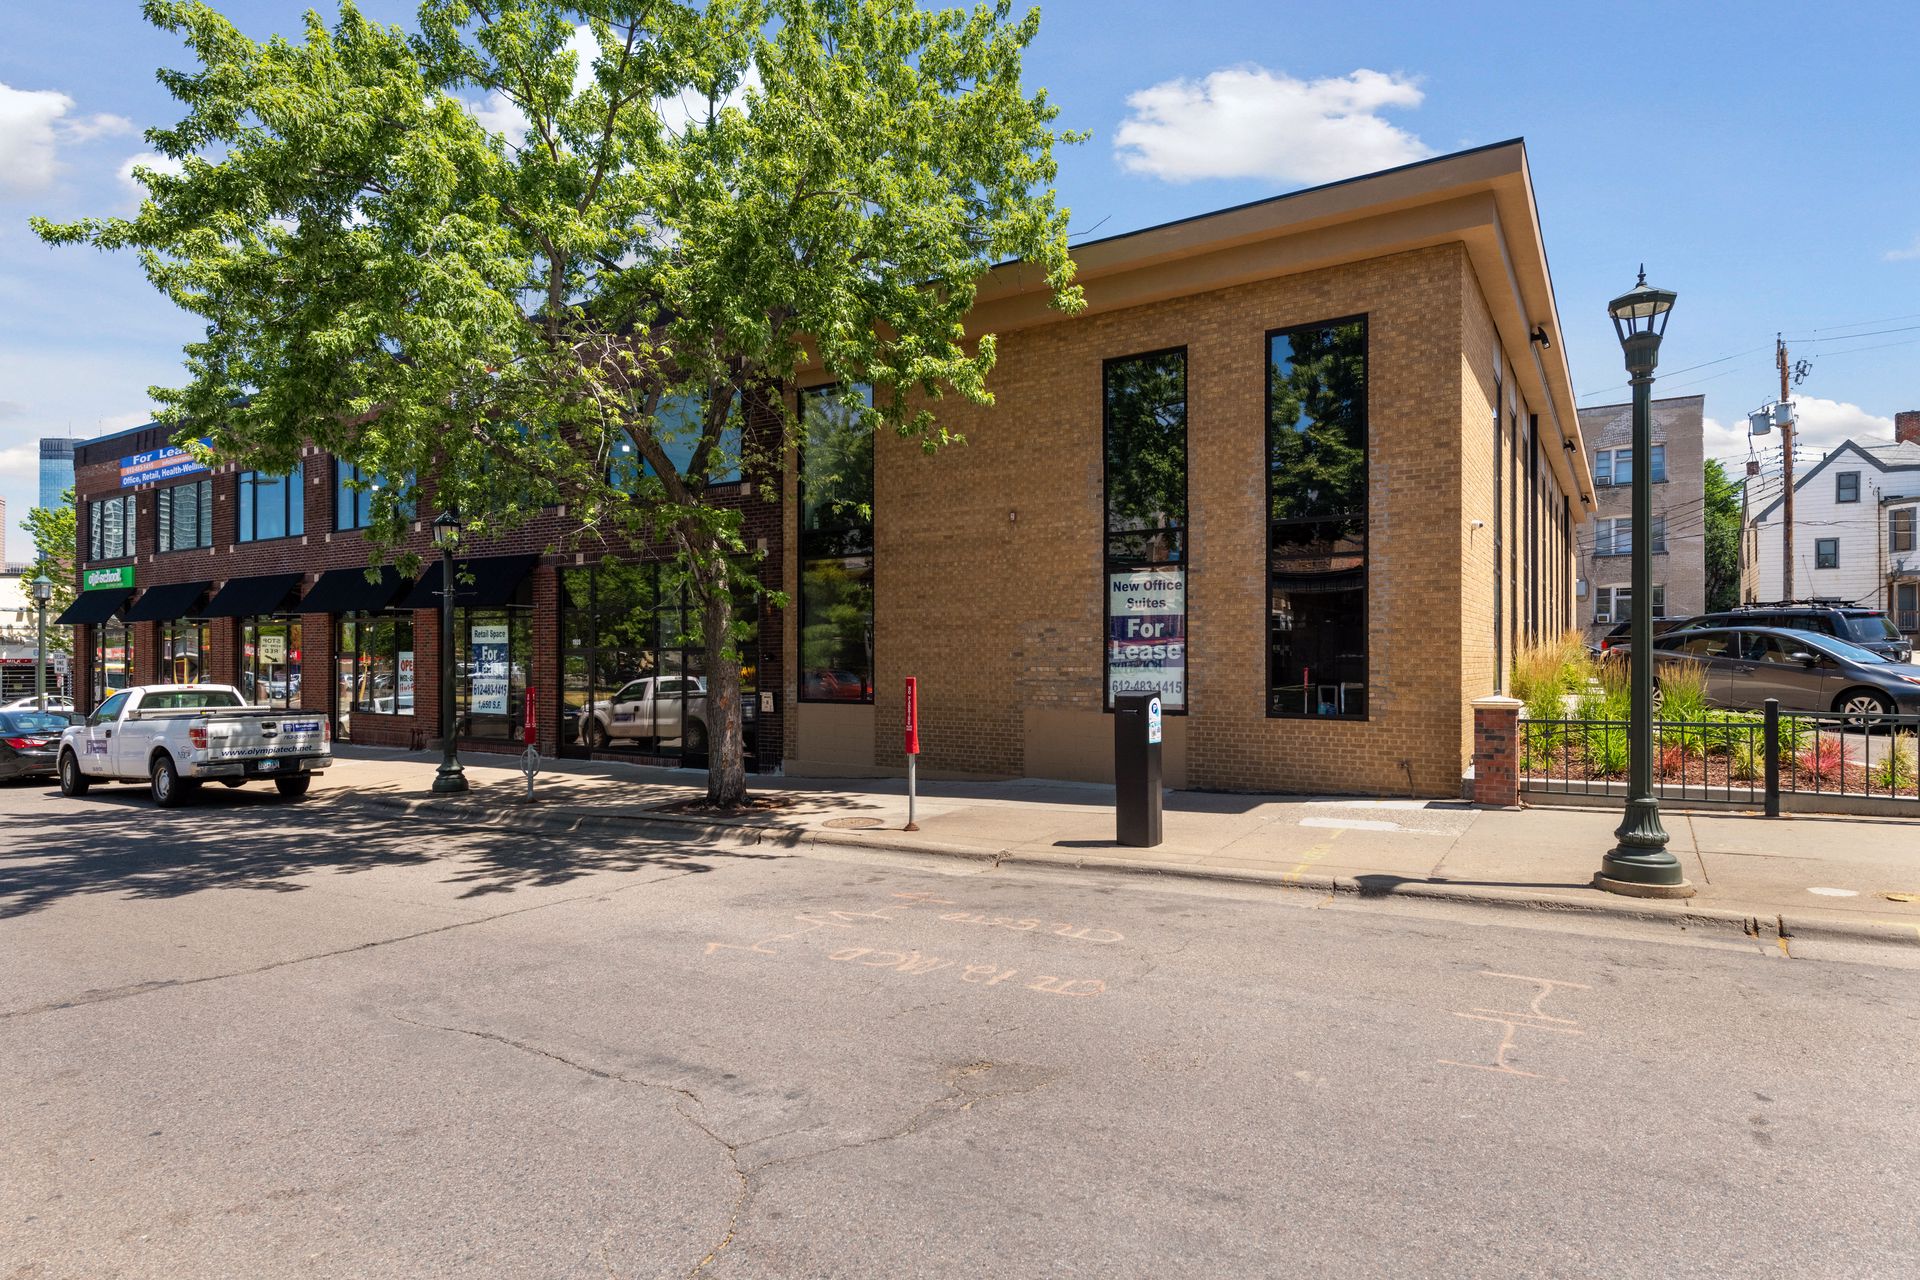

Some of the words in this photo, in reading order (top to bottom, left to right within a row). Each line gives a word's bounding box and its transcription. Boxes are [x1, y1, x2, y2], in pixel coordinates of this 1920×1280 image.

[133, 453, 152, 465] For
[123, 475, 141, 485] Office,
[142, 471, 160, 482] Retail,
[1113, 581, 1139, 592] New
[1143, 579, 1183, 591] Office
[1127, 597, 1166, 608] Suites
[474, 629, 489, 638] Retail
[490, 629, 506, 640] Space
[1127, 618, 1165, 638] For
[481, 645, 498, 660] For
[1113, 640, 1182, 660] Lease
[221, 744, 313, 757] www.olympiatech.net
